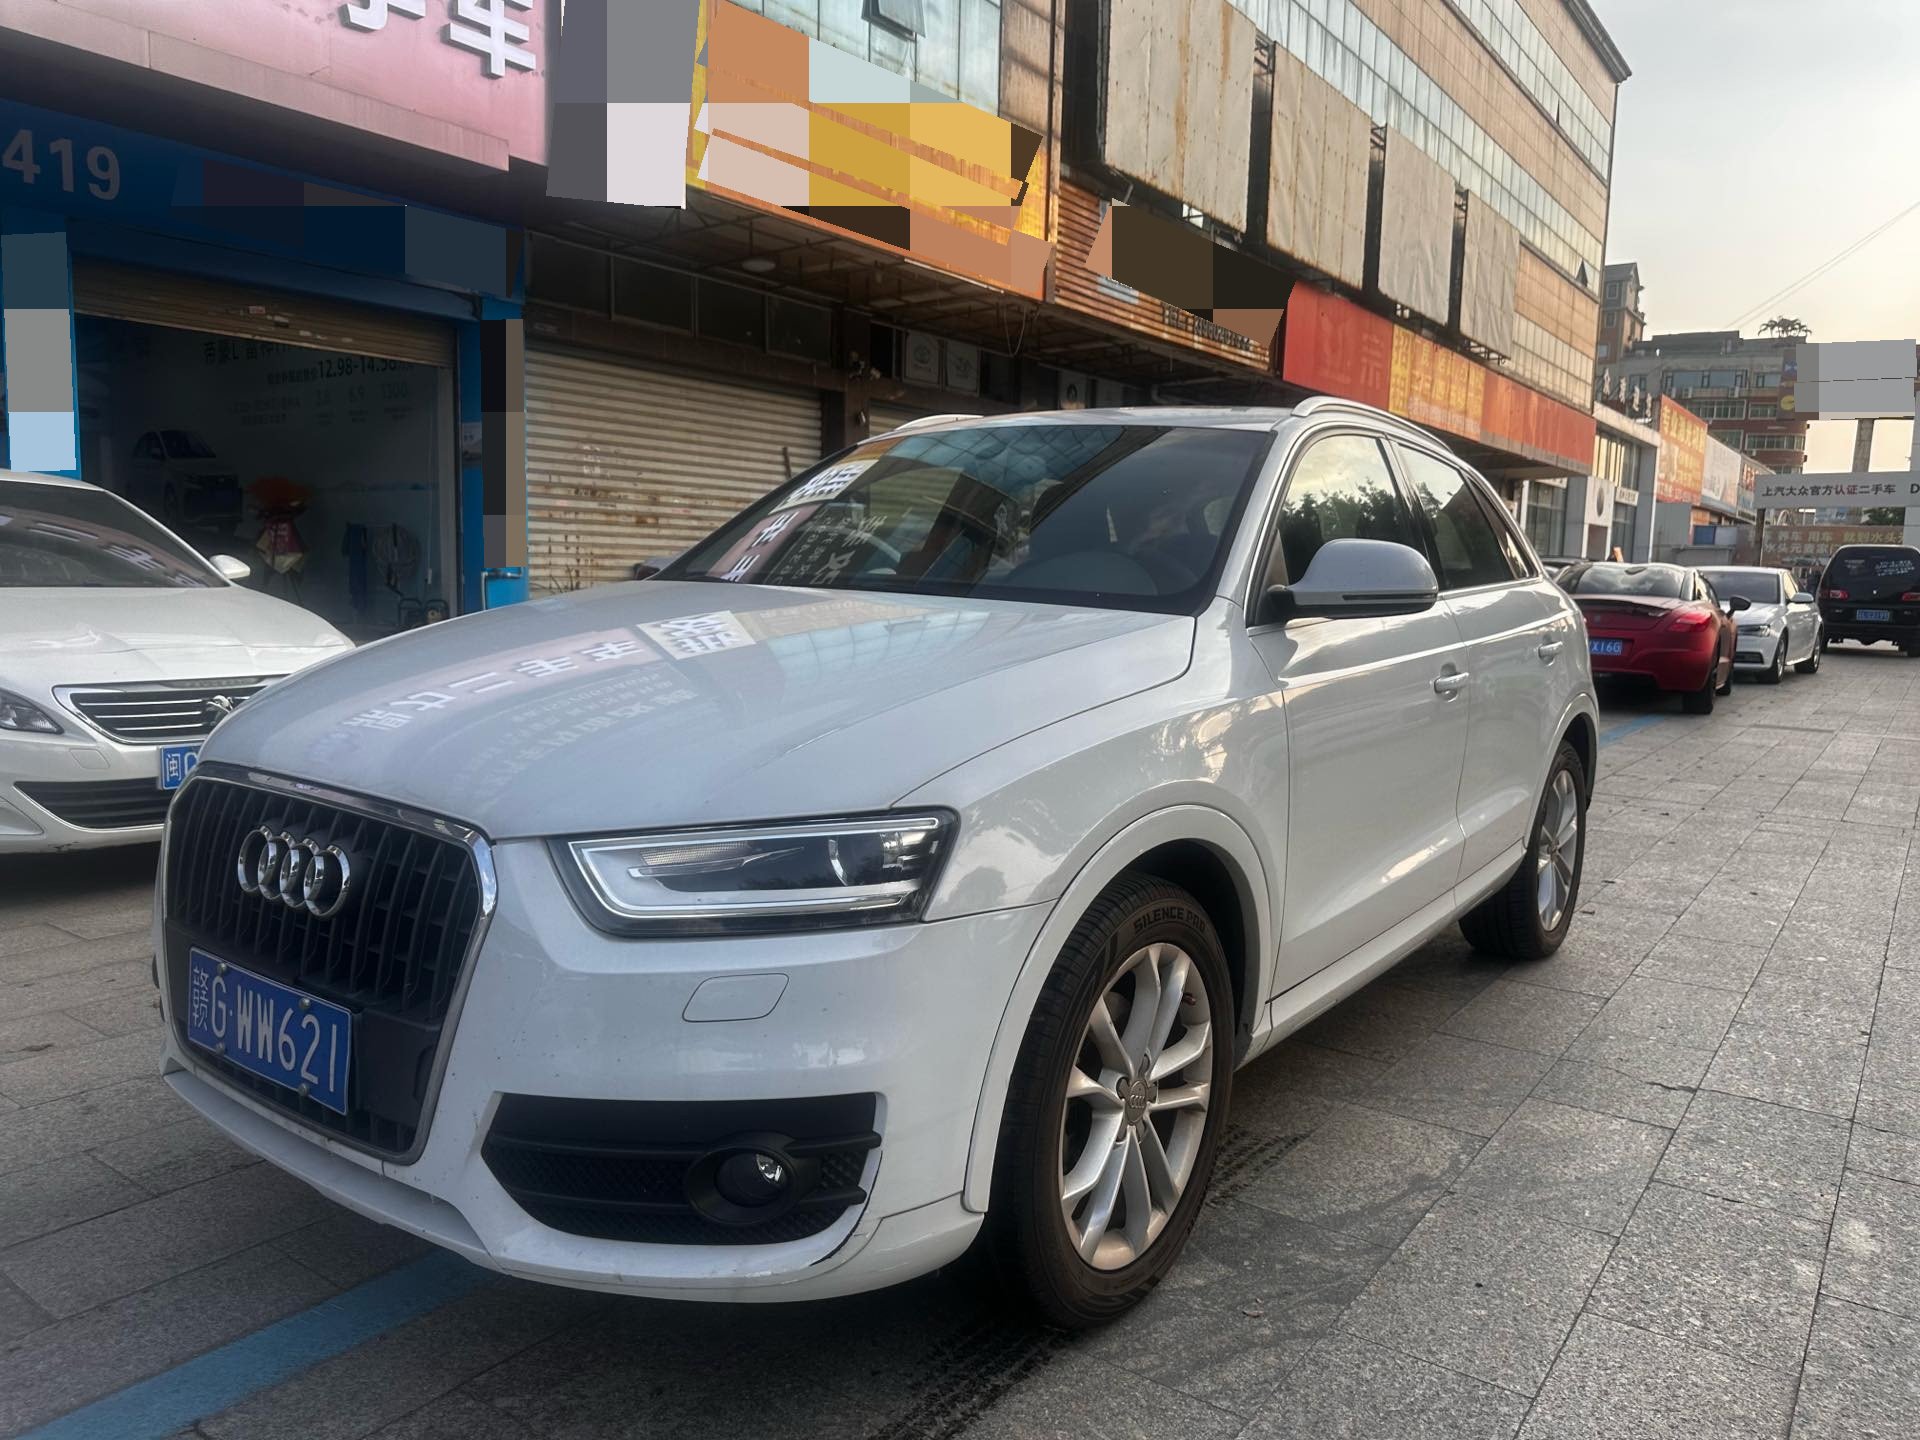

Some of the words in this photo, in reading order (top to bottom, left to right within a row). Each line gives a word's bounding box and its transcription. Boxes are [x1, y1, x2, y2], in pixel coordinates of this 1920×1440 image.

[2, 128, 120, 201] 419
[1762, 483, 1897, 497] 上汽大众官方认证二手车
[1134, 906, 1185, 935] SILENCE
